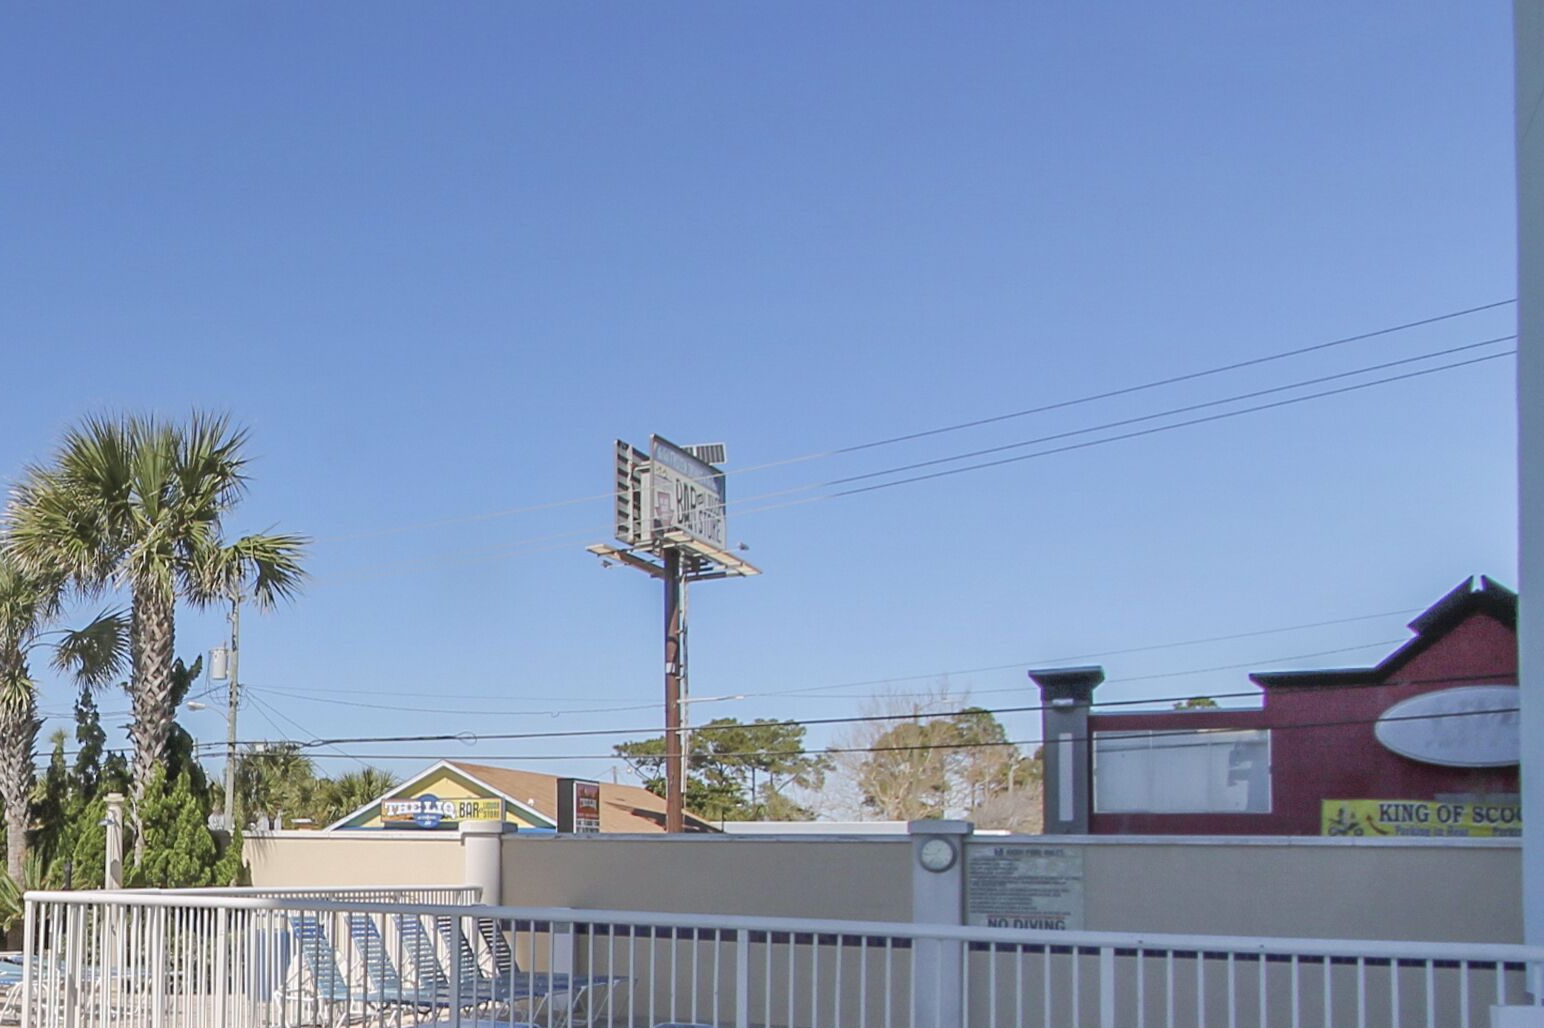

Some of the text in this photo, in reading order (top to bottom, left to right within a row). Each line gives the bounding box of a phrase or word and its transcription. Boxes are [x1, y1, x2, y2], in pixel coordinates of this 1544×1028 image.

[385, 801, 422, 816] THE
[423, 801, 456, 819] LIQ
[459, 802, 480, 818] BAR
[1378, 804, 1430, 823] KING
[1437, 805, 1465, 823] OF
[988, 919, 1066, 930] NO DIVING
